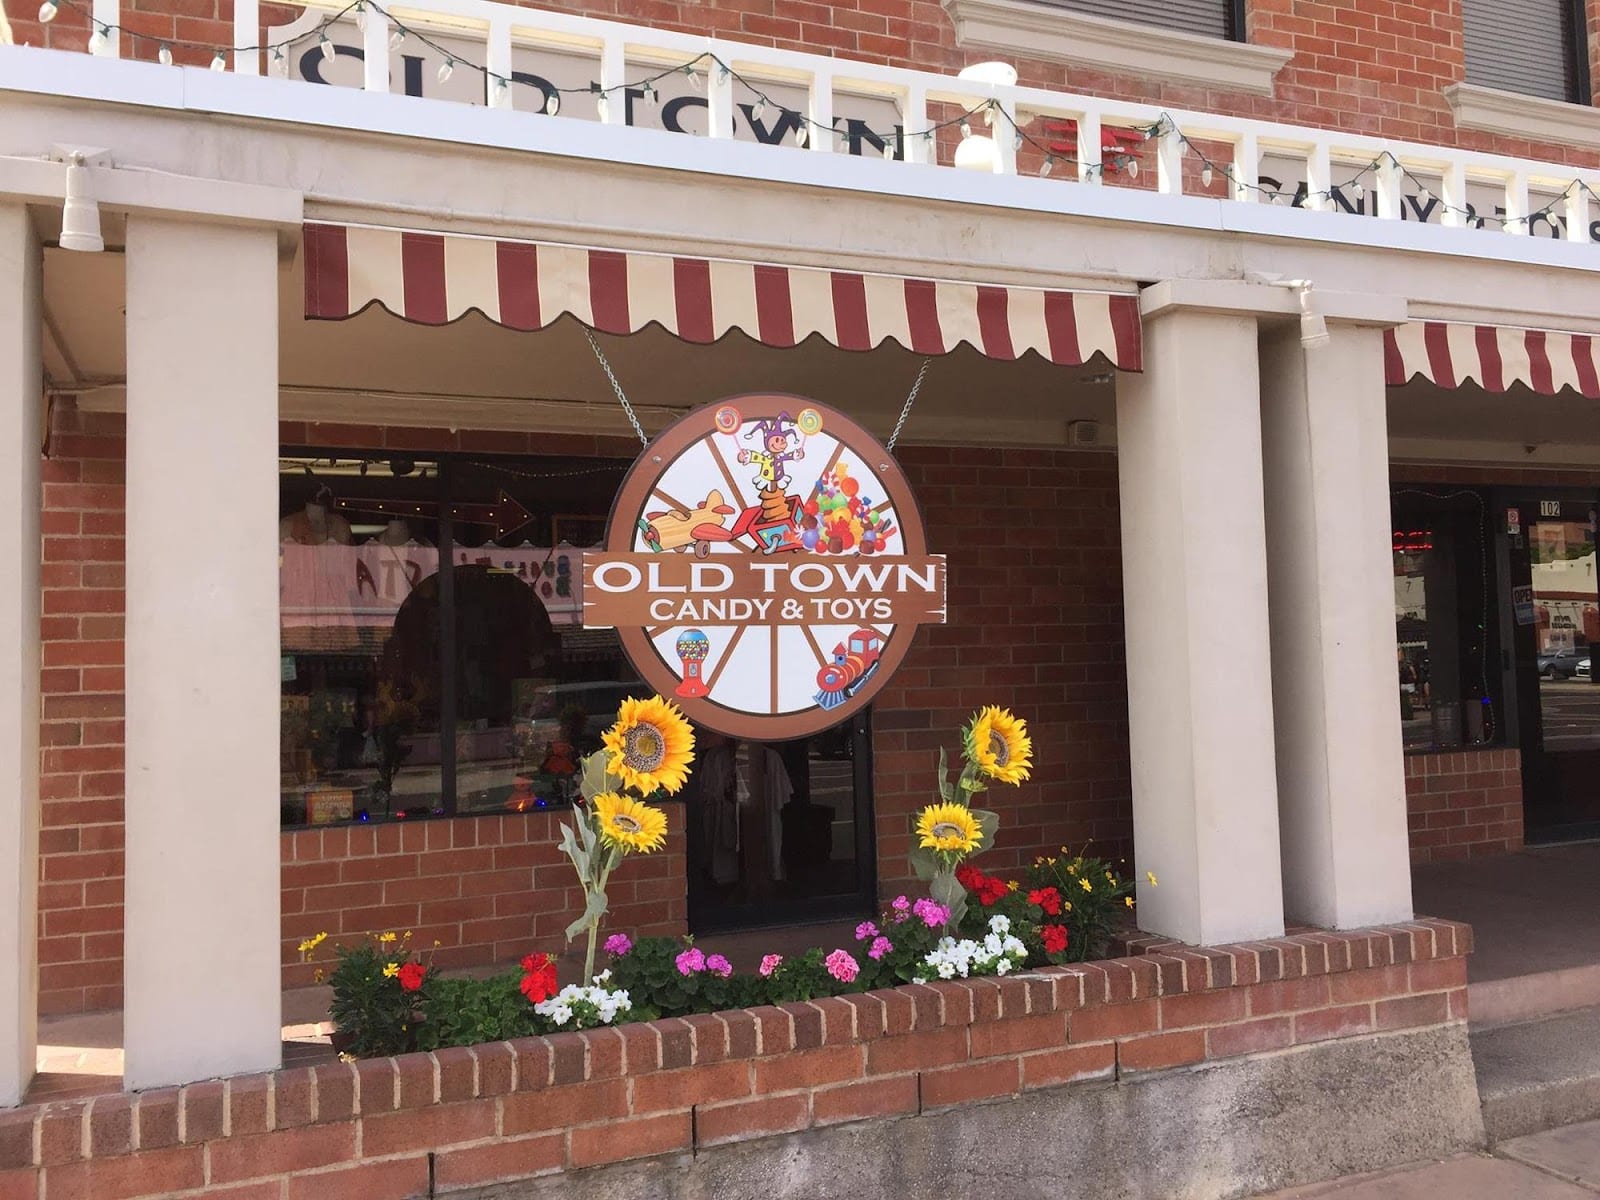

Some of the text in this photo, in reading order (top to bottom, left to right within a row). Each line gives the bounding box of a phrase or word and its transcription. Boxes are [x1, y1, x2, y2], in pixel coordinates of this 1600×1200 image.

[1542, 502, 1559, 515] 102
[592, 561, 734, 593] OLD
[750, 562, 936, 593] TOWN
[1515, 588, 1533, 604] OPE
[649, 598, 892, 621] CANDY & TOYS
